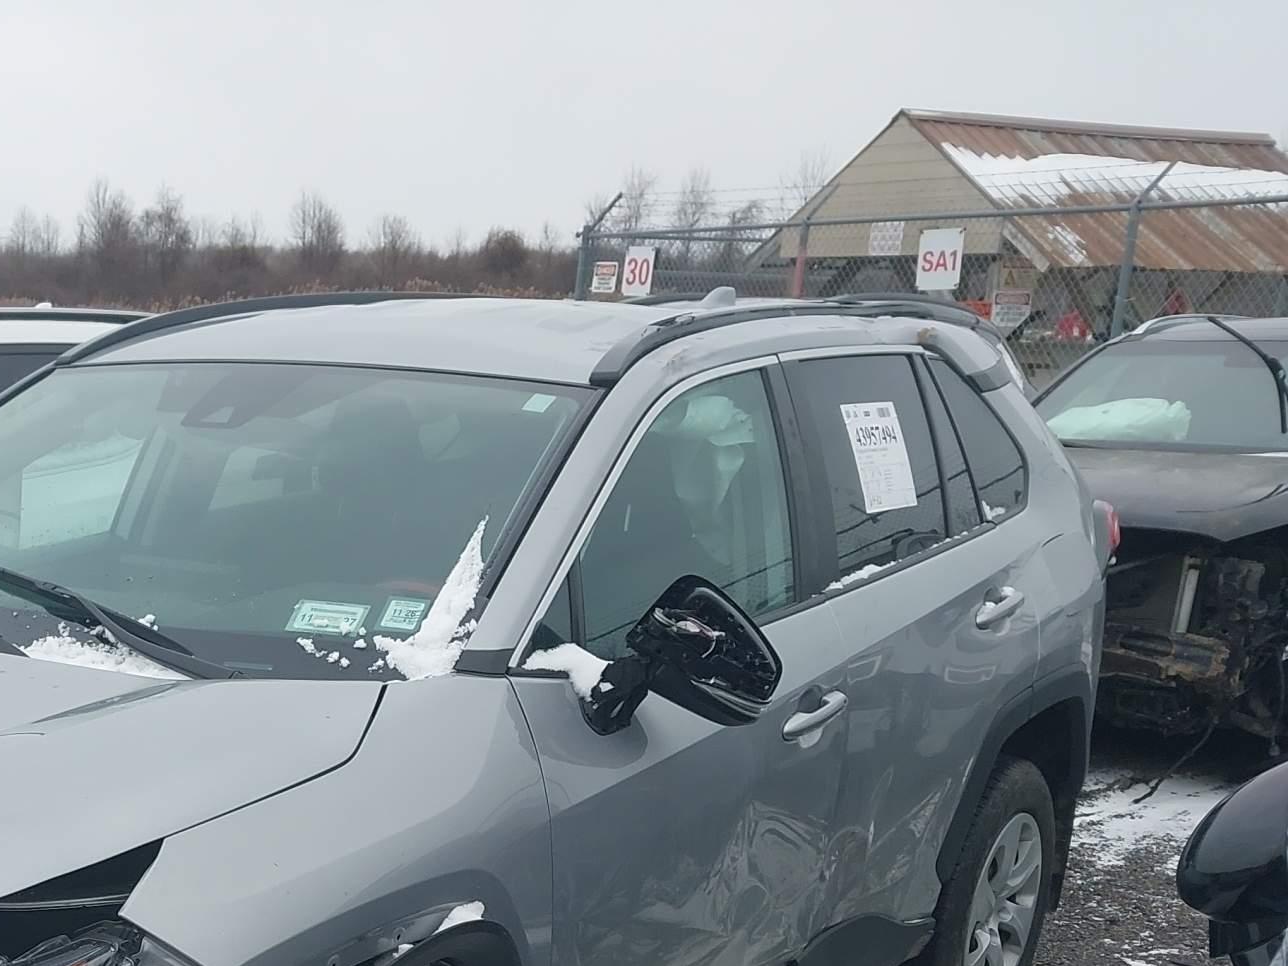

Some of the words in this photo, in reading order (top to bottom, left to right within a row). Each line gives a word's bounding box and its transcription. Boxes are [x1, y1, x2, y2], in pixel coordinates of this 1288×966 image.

[626, 258, 650, 286] 30
[921, 249, 958, 272] SA1
[855, 425, 898, 446] 43957494
